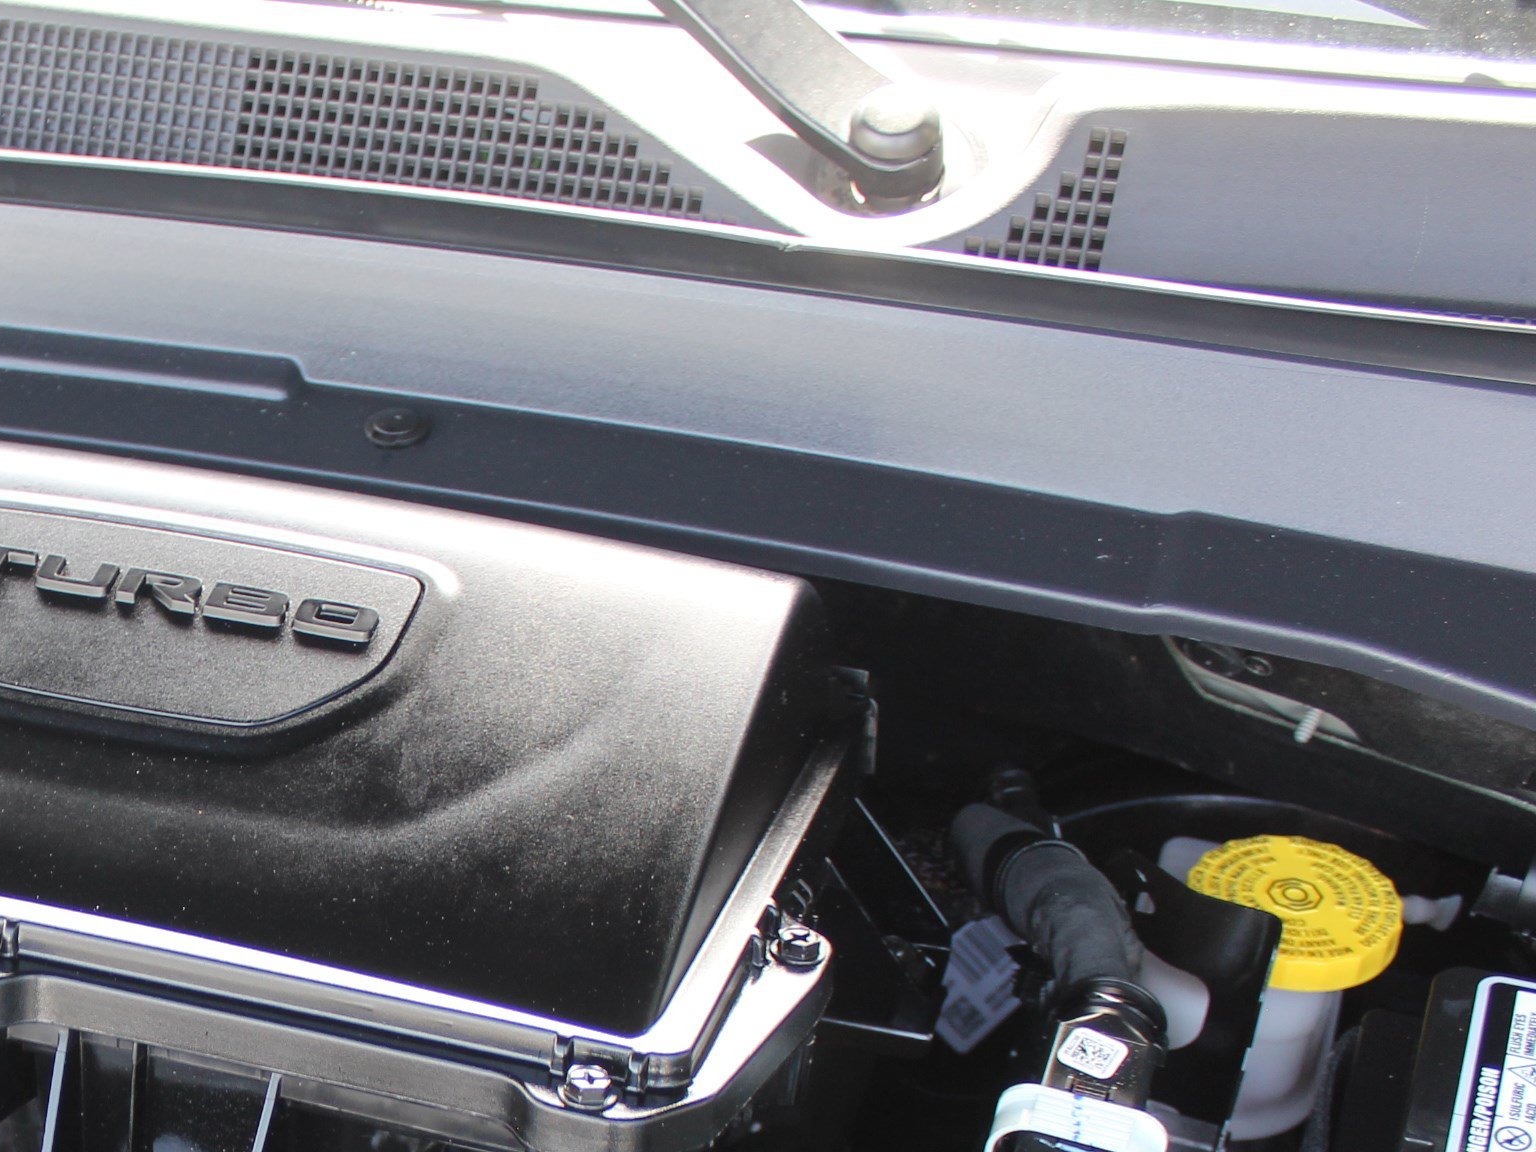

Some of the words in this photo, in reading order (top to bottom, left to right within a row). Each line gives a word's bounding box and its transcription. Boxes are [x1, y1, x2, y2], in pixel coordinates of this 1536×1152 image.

[1514, 1013, 1527, 1032] EYES
[1509, 1033, 1524, 1055] FLUSH
[1513, 1082, 1526, 1117] SULFURIC
